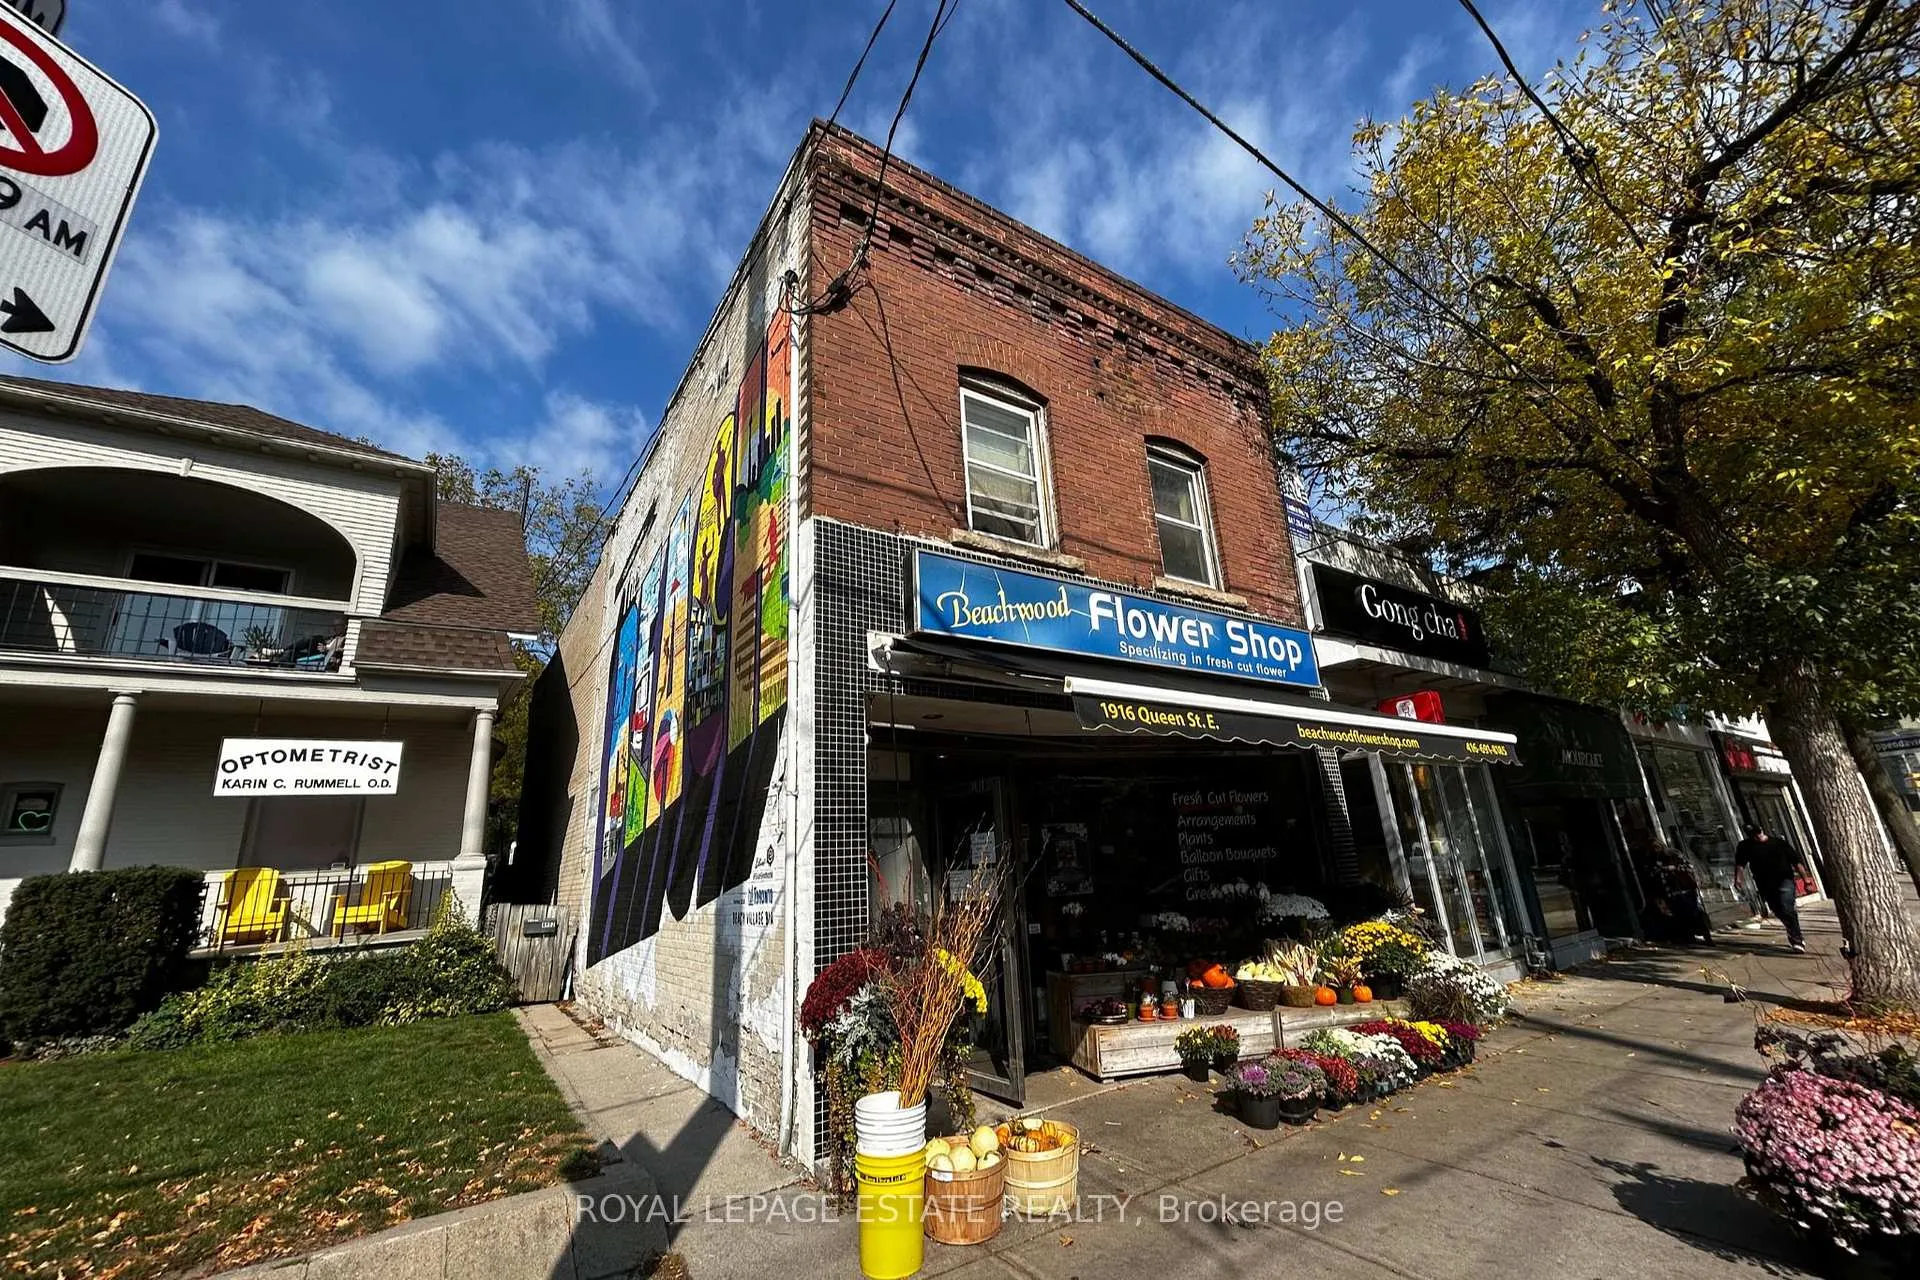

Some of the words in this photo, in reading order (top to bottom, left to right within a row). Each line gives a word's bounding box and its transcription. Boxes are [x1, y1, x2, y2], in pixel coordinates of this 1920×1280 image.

[24, 208, 87, 256] AM
[1361, 584, 1424, 641] Gong
[1424, 603, 1458, 640] cha
[936, 586, 1071, 628] Beachwood
[1089, 592, 1215, 649] Flower
[1226, 622, 1303, 672] Shop
[1191, 653, 1203, 665] in
[1206, 655, 1234, 670] fresh
[1237, 661, 1254, 673] cut
[1256, 664, 1287, 678] flower
[1100, 702, 1136, 721] 1916
[1138, 706, 1186, 727] Queen
[1187, 712, 1205, 728] St.
[1206, 715, 1219, 730] E.
[1296, 723, 1420, 749] beachwoodflowershop.com
[221, 748, 397, 774] OPTOMETRIST
[222, 779, 267, 789] KARIN
[273, 779, 286, 789] C.
[294, 779, 360, 788] RUMMELL
[367, 779, 391, 788] O.D.
[1172, 791, 1202, 805] Fresh
[1207, 792, 1226, 804] Cut
[1229, 791, 1269, 804] Flowers
[1177, 815, 1257, 830] Arrangements
[1178, 832, 1214, 845] Plants
[1181, 849, 1223, 863] Balloon
[1226, 846, 1277, 862] Bouquets
[1183, 868, 1210, 882] Gifts
